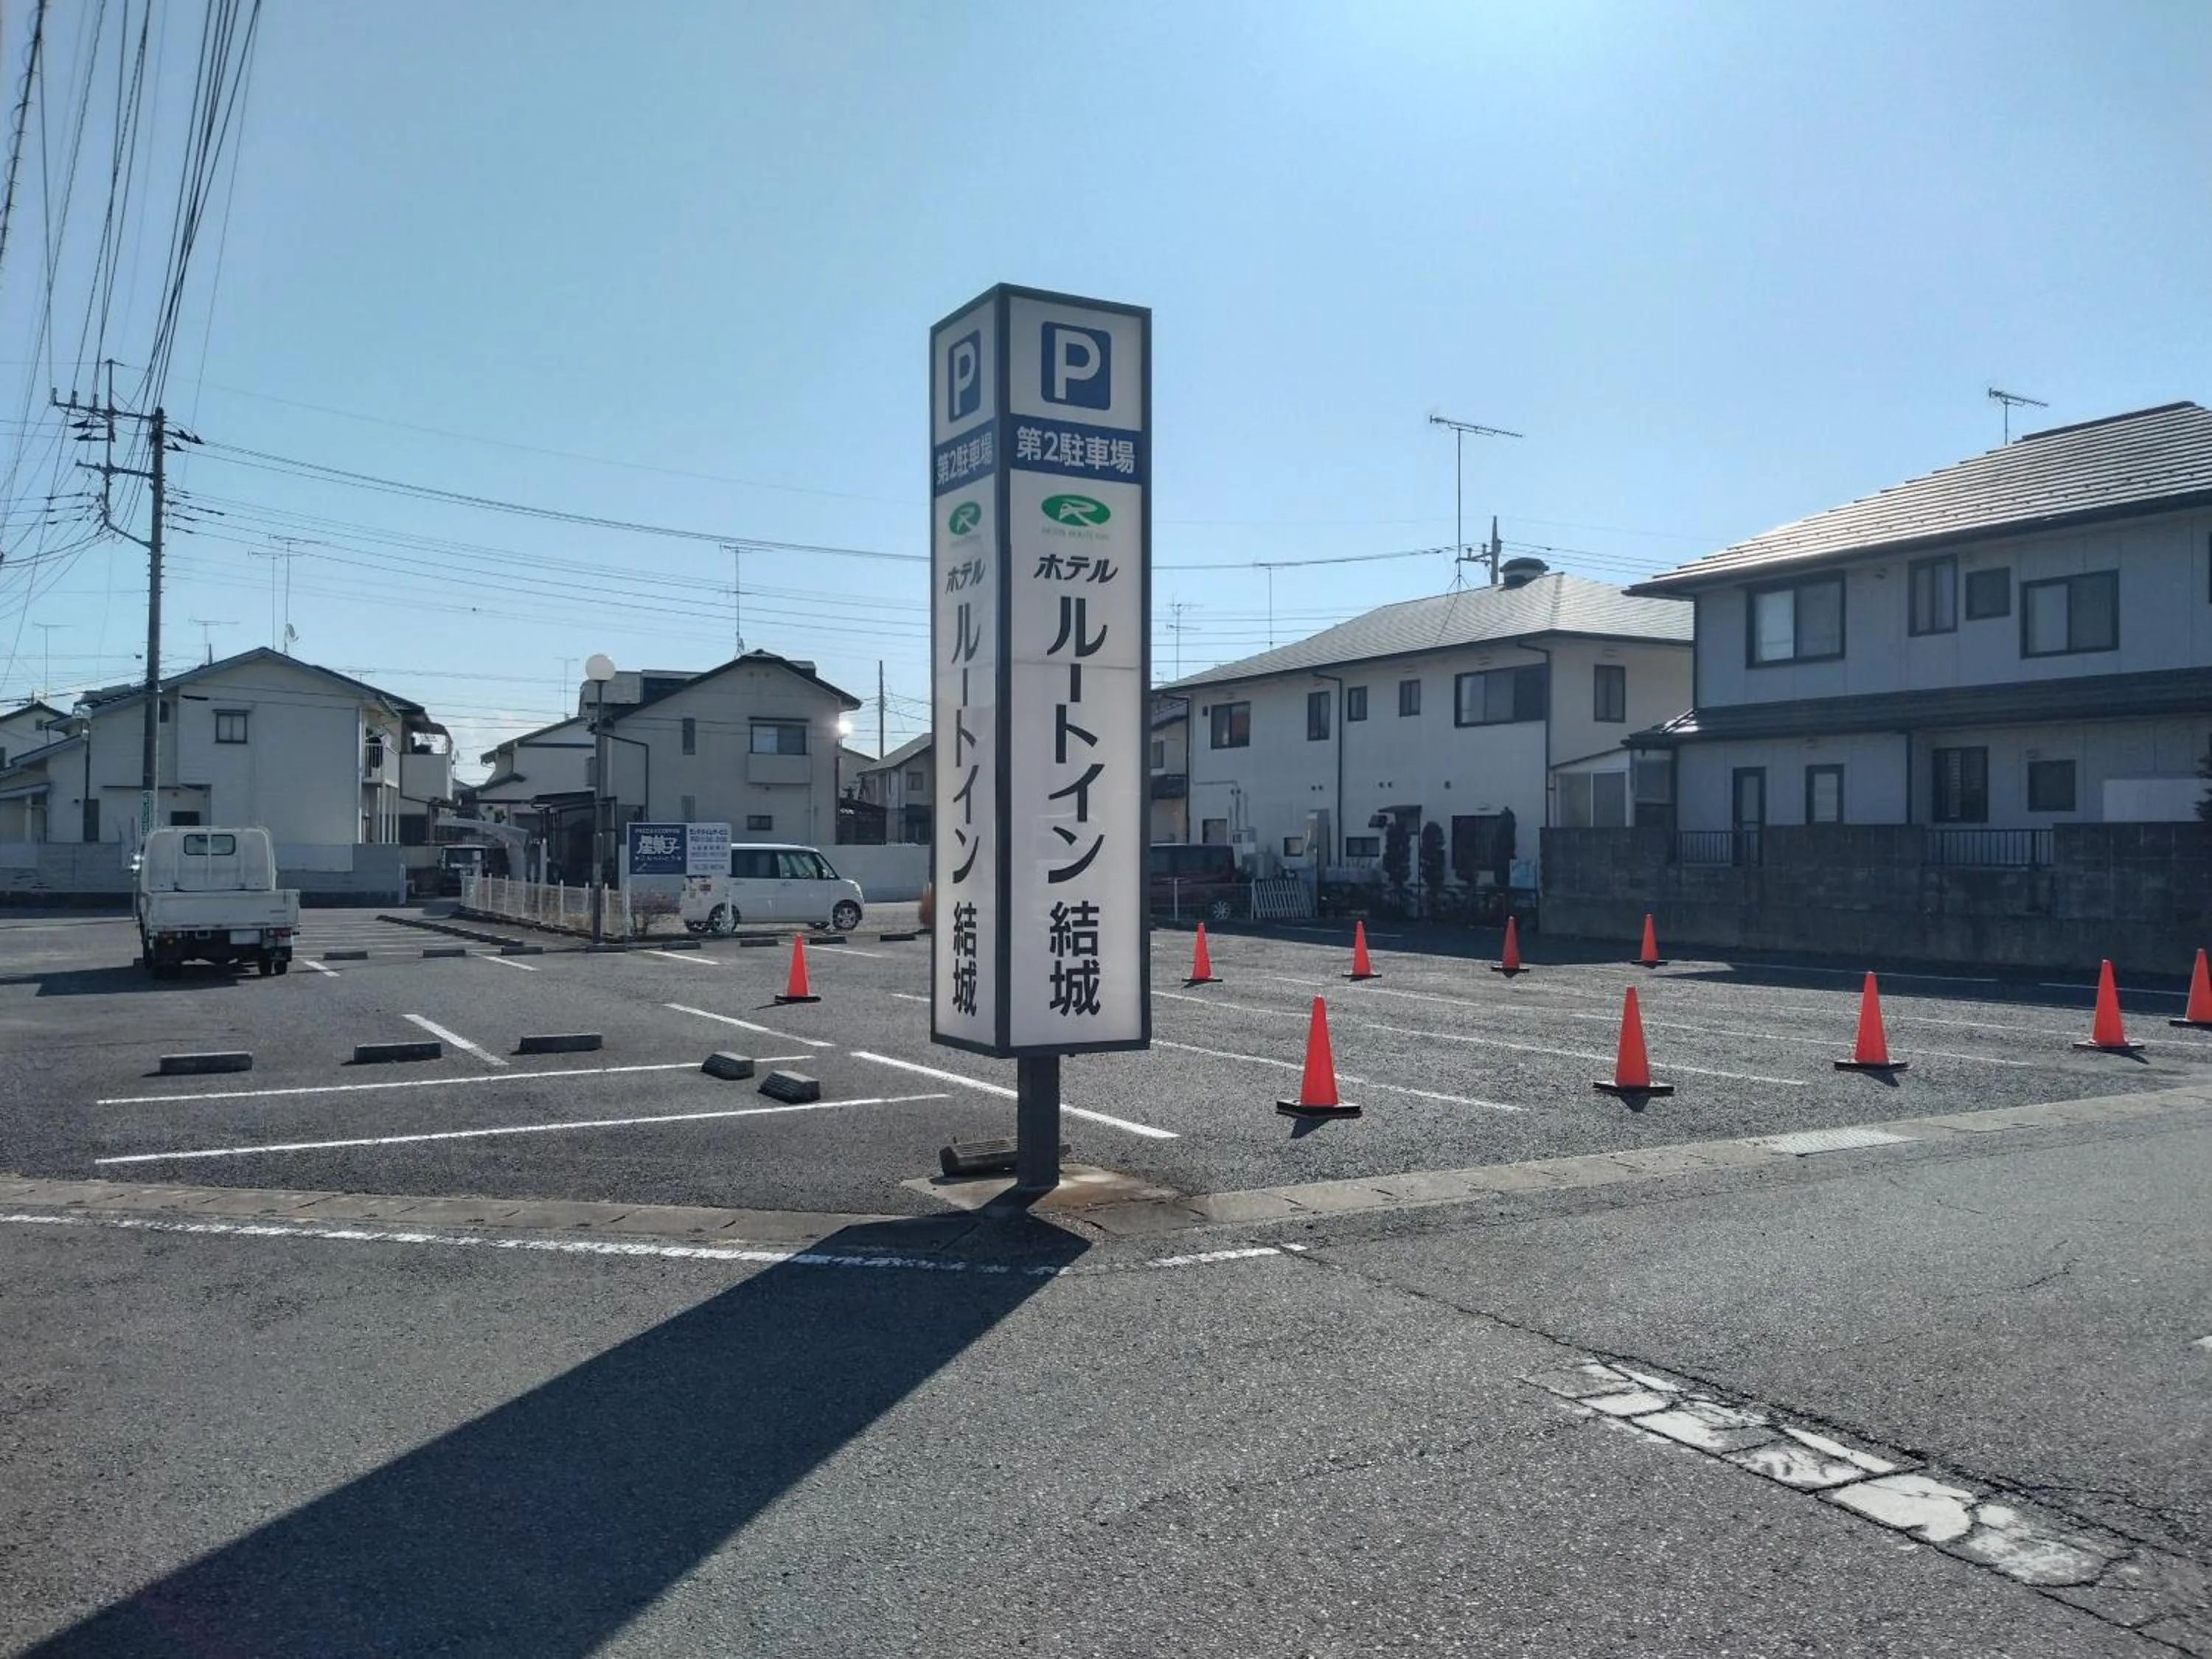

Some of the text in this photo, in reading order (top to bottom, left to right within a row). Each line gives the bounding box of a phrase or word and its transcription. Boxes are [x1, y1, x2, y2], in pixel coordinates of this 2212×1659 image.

[953, 341, 976, 417] P
[1054, 328, 1102, 400] P
[937, 431, 992, 484] 第2駐車場
[1016, 425, 1135, 475] 第2駐車場
[945, 558, 986, 596] ホテル
[1033, 554, 1119, 583] ホテル
[1047, 596, 1108, 884] ルートイン
[951, 602, 981, 1017] ルートイン 結城
[1049, 900, 1101, 1017] 結城
